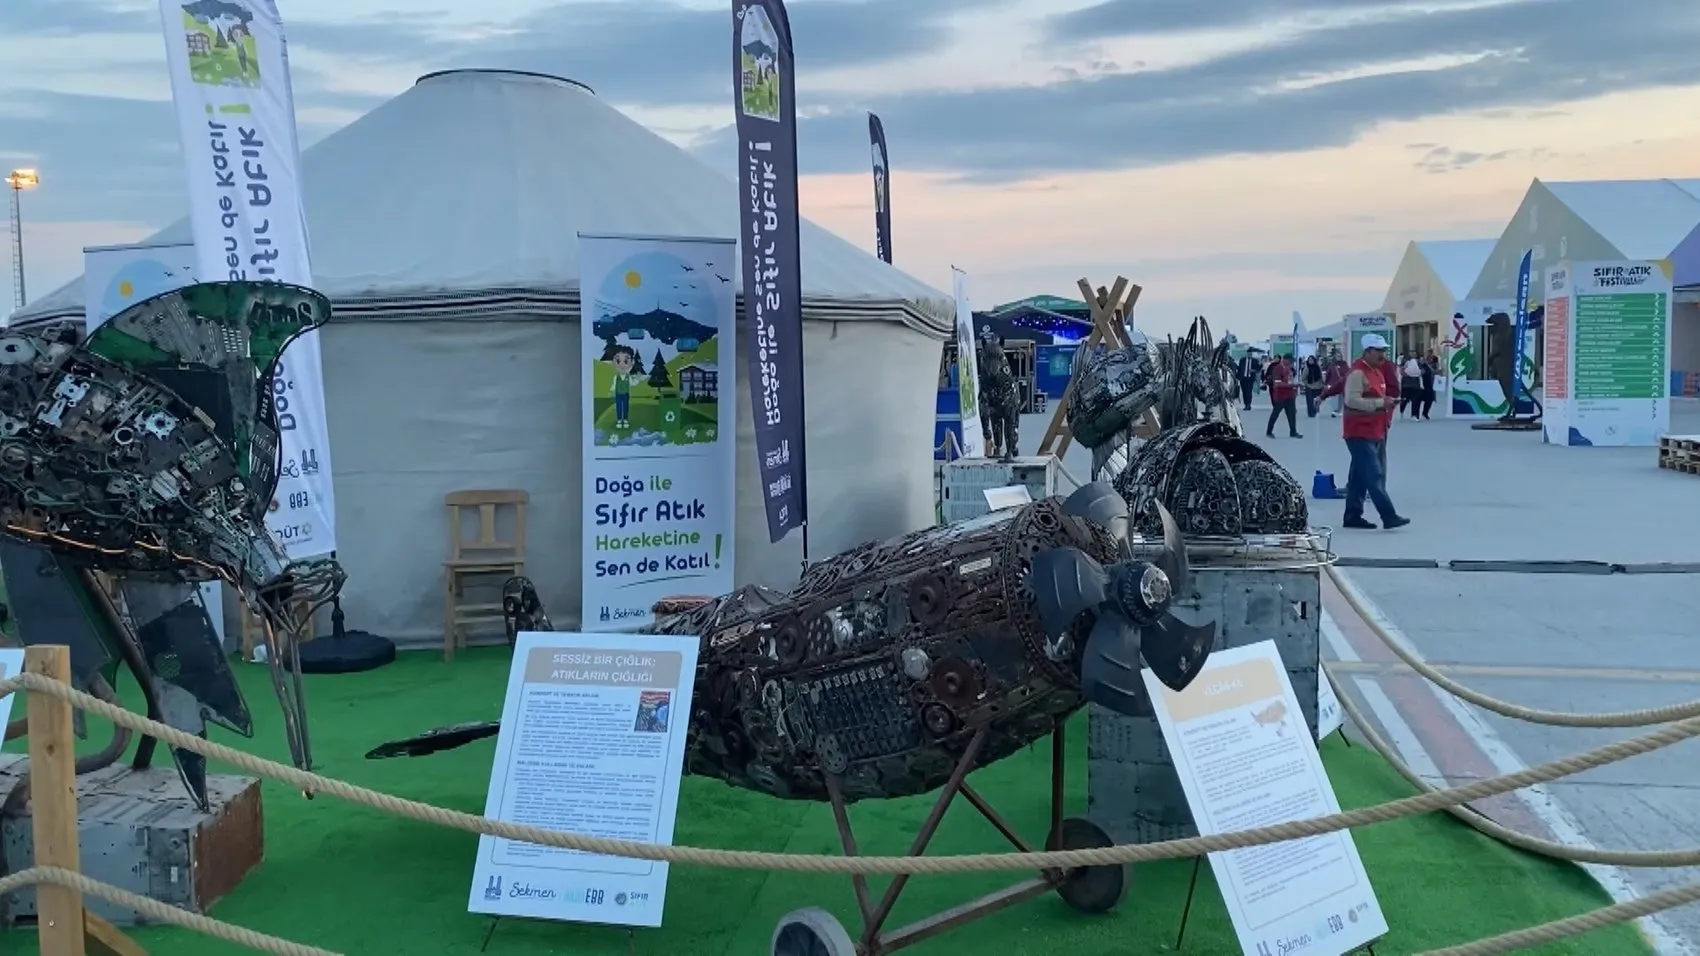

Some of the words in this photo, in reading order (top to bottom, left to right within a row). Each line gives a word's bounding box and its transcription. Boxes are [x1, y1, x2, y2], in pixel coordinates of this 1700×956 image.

[1593, 266, 1623, 277] SIFIR
[1627, 265, 1651, 276] ATIK
[595, 475, 644, 497] Doğa
[650, 476, 672, 491] ile
[595, 503, 648, 528] Sıfır
[656, 499, 705, 521] Atık
[595, 530, 701, 551] Hareketine
[595, 560, 630, 577] Sen
[636, 557, 660, 574] de
[552, 652, 592, 665] SESSİZ
[594, 653, 612, 665] BİR
[551, 669, 609, 681] ATIKLARIN
[611, 671, 653, 684] ÇIĞLIĞI
[509, 882, 556, 899] Sekmen
[585, 888, 604, 904] EBB
